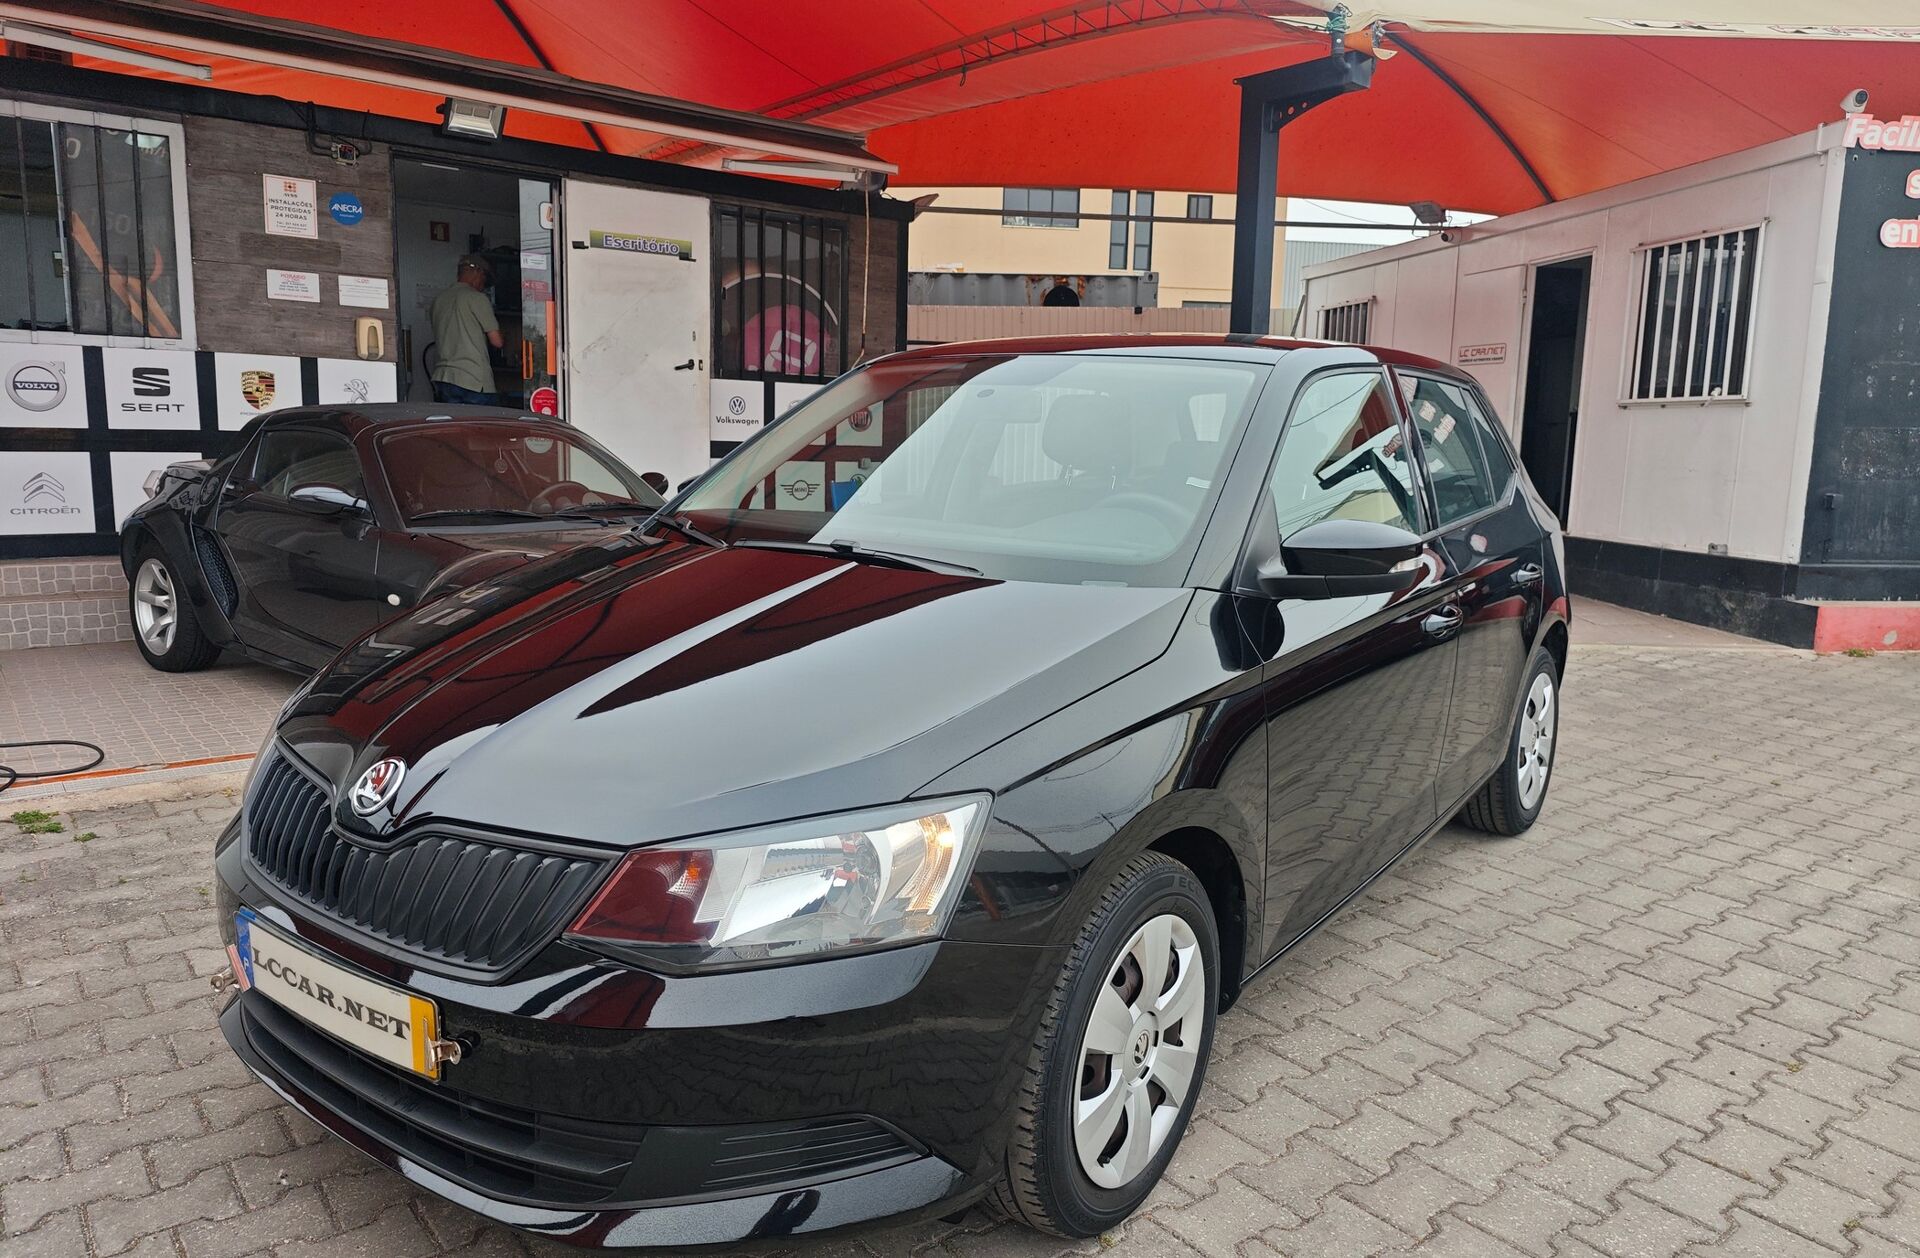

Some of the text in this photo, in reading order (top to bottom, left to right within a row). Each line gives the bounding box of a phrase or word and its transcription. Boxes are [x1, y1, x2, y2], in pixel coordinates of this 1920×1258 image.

[1844, 115, 1920, 149] Facil
[270, 205, 312, 214] PROTEGIDAS
[331, 203, 362, 214] ANECRA
[603, 234, 681, 255] Escritório
[1459, 349, 1469, 357] LC
[15, 382, 58, 390] VOLVO
[121, 403, 185, 413] SEAT
[716, 416, 759, 425] Volkswagen
[251, 946, 411, 1041] LCCAR.NET
